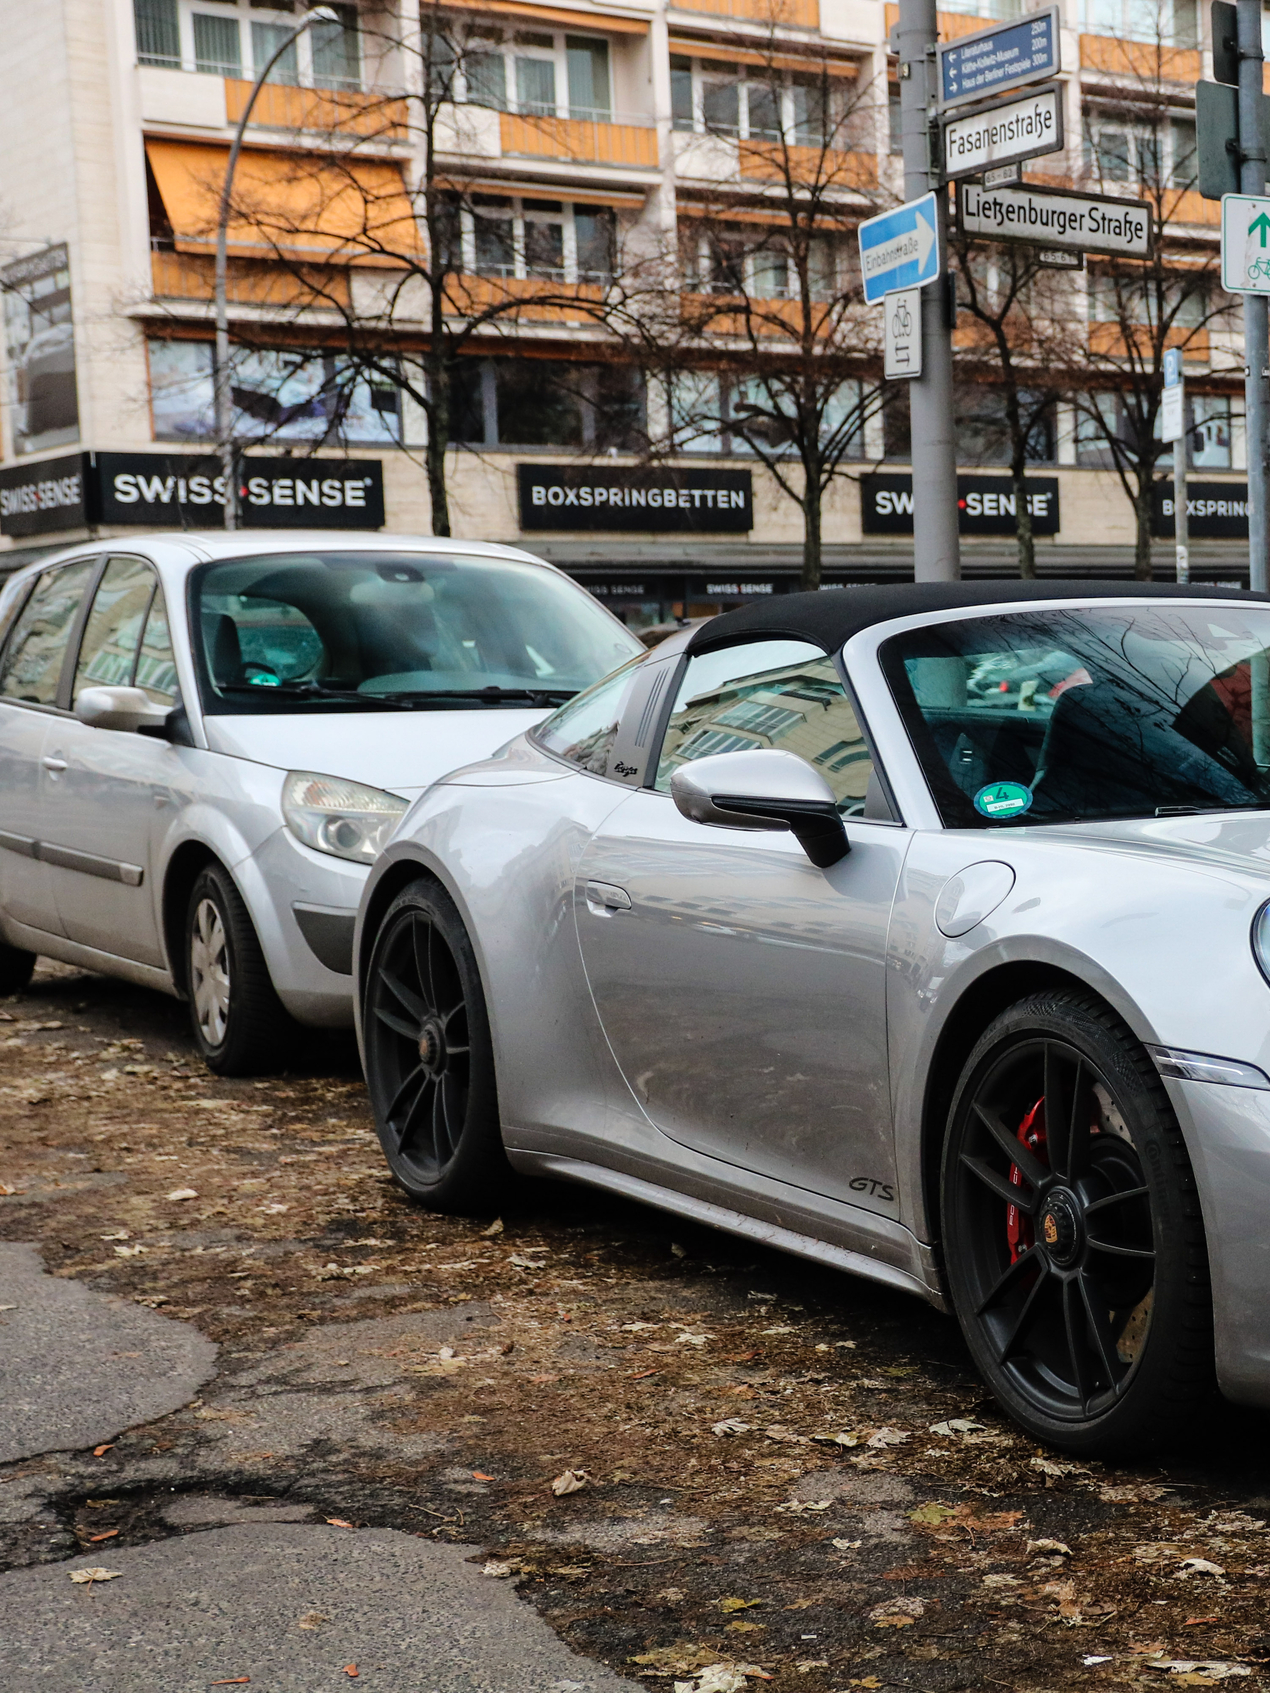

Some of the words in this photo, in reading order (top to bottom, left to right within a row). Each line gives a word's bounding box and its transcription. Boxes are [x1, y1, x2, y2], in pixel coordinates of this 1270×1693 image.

[949, 103, 1052, 157] Fasanenstraße
[965, 189, 1086, 234] Lietzenburger
[1088, 207, 1144, 243] Straße
[865, 237, 919, 272] Einbahnstraße
[0, 484, 37, 516] SWISS
[38, 476, 81, 510] SENSE
[114, 473, 227, 505] SWISS
[248, 477, 367, 507] SENSE
[532, 485, 745, 508] BOXSPRINGBETTEN
[706, 583, 739, 595] SWISS
[740, 583, 774, 595] SENSE
[996, 787, 1009, 800] 4
[849, 1177, 894, 1202] GTS
